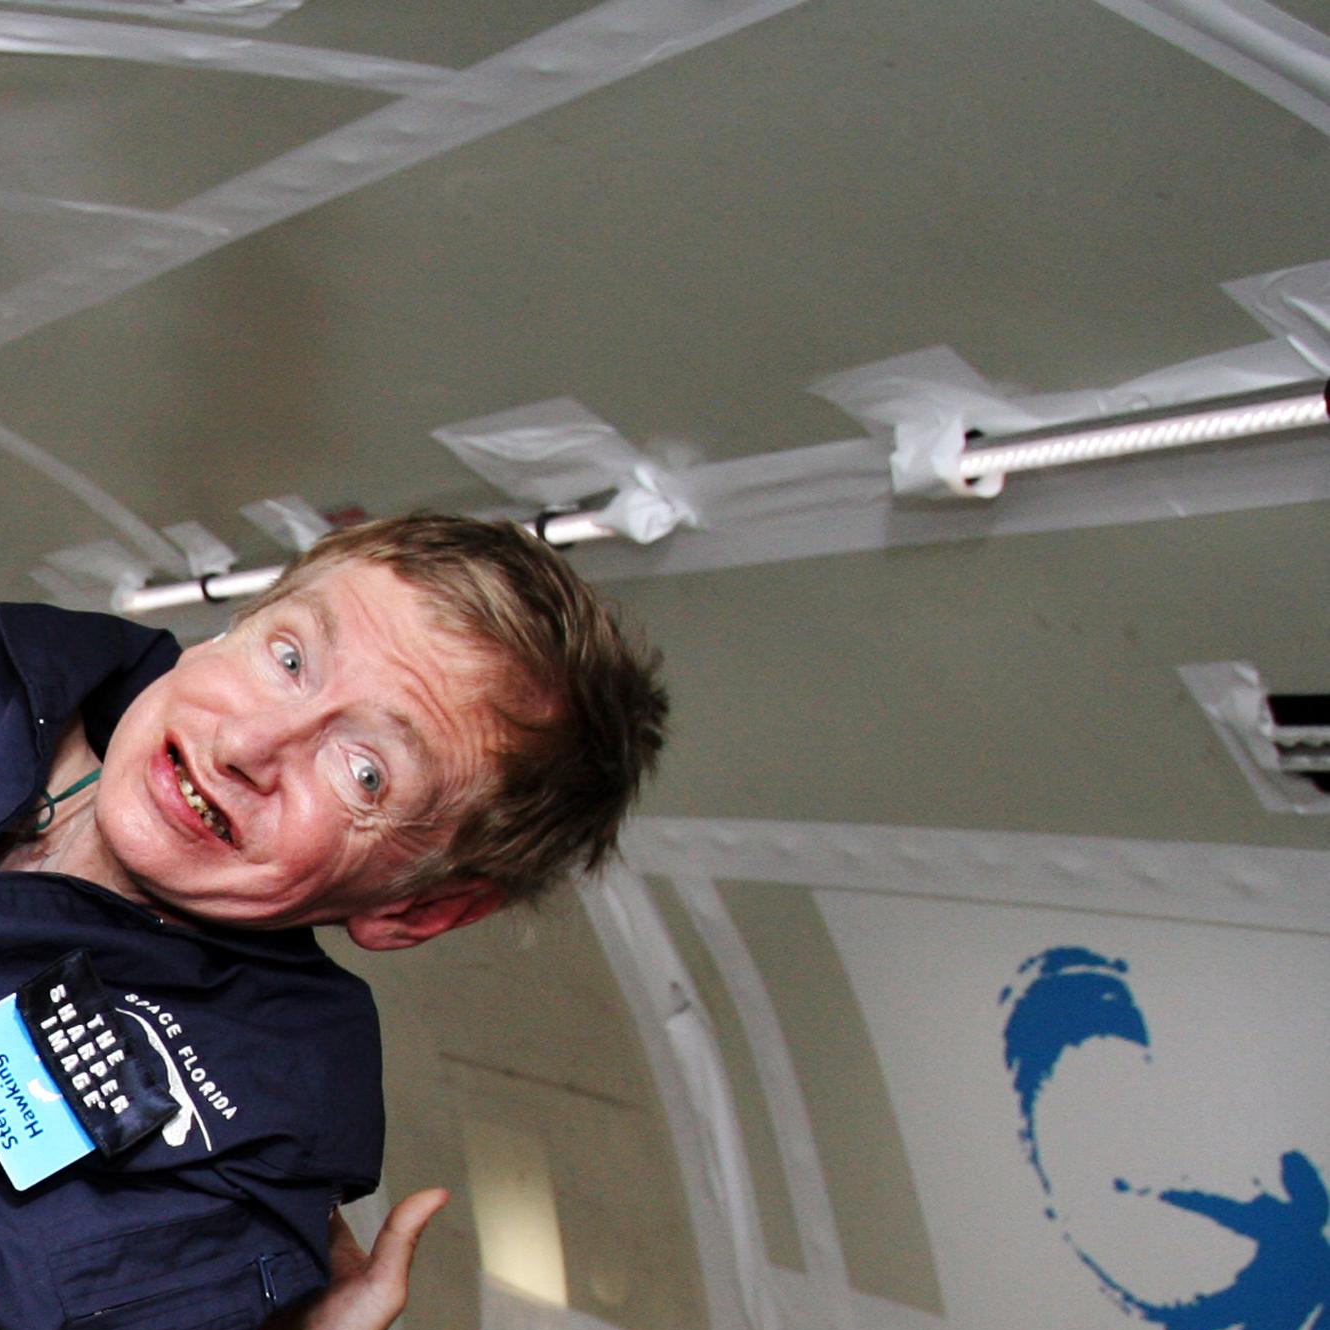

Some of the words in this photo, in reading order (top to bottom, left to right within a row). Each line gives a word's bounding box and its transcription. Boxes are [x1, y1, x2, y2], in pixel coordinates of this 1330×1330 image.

[48, 983, 130, 1115] SHARPER
[87, 1012, 126, 1067] THE
[124, 993, 183, 1039] SPACE
[178, 1045, 238, 1121] FLORIDA
